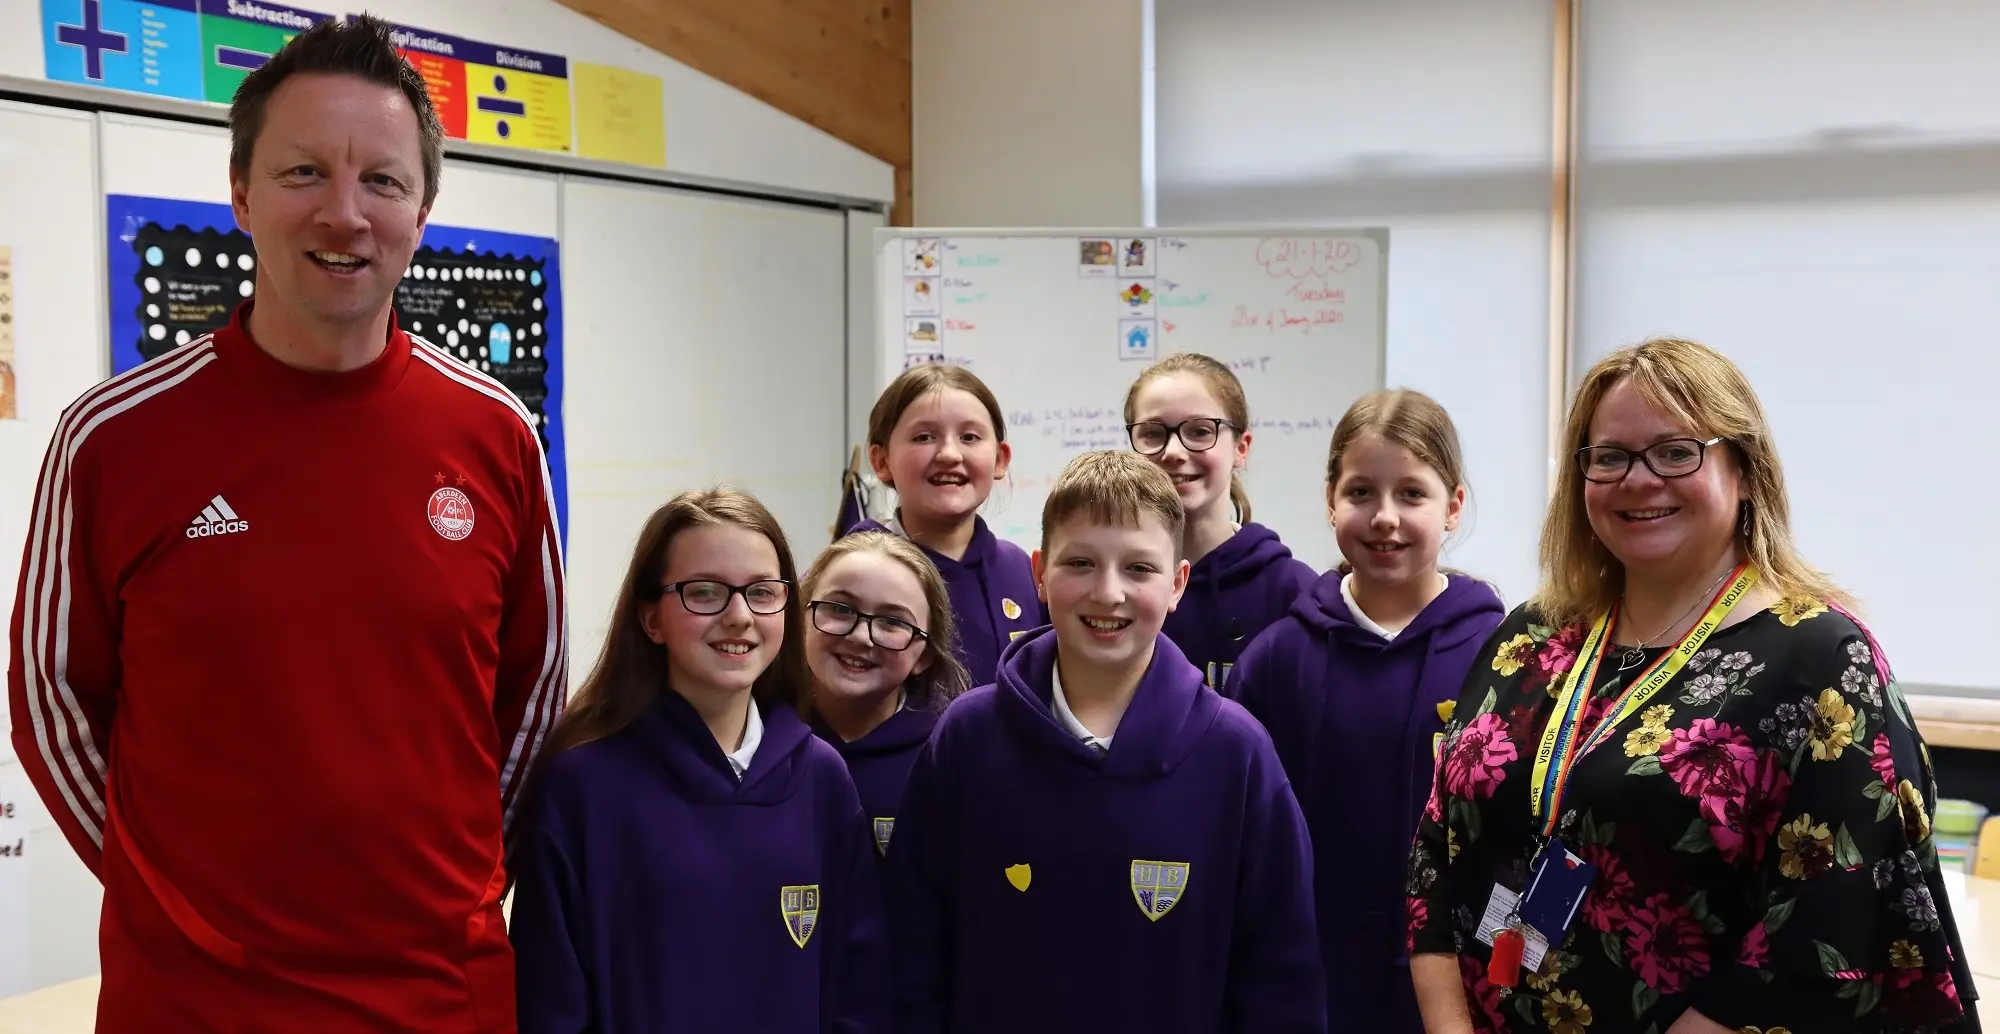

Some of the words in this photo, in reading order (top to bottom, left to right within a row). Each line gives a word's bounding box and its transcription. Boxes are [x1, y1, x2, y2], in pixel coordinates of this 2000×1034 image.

[227, 0, 313, 28] Subtraction
[389, 29, 454, 55] iplication
[496, 50, 543, 71] Division
[435, 490, 467, 505] ABERDEEN
[186, 520, 249, 539] adidas
[431, 515, 462, 538] FOOTBALL
[462, 518, 473, 535] CLUB
[1721, 576, 1752, 607] VISITOR
[1681, 621, 1714, 656] VISITOR
[1634, 670, 1672, 701] VISITOR
[1538, 727, 1557, 764] VISITOR
[787, 893, 799, 908] H
[806, 892, 815, 908] B
